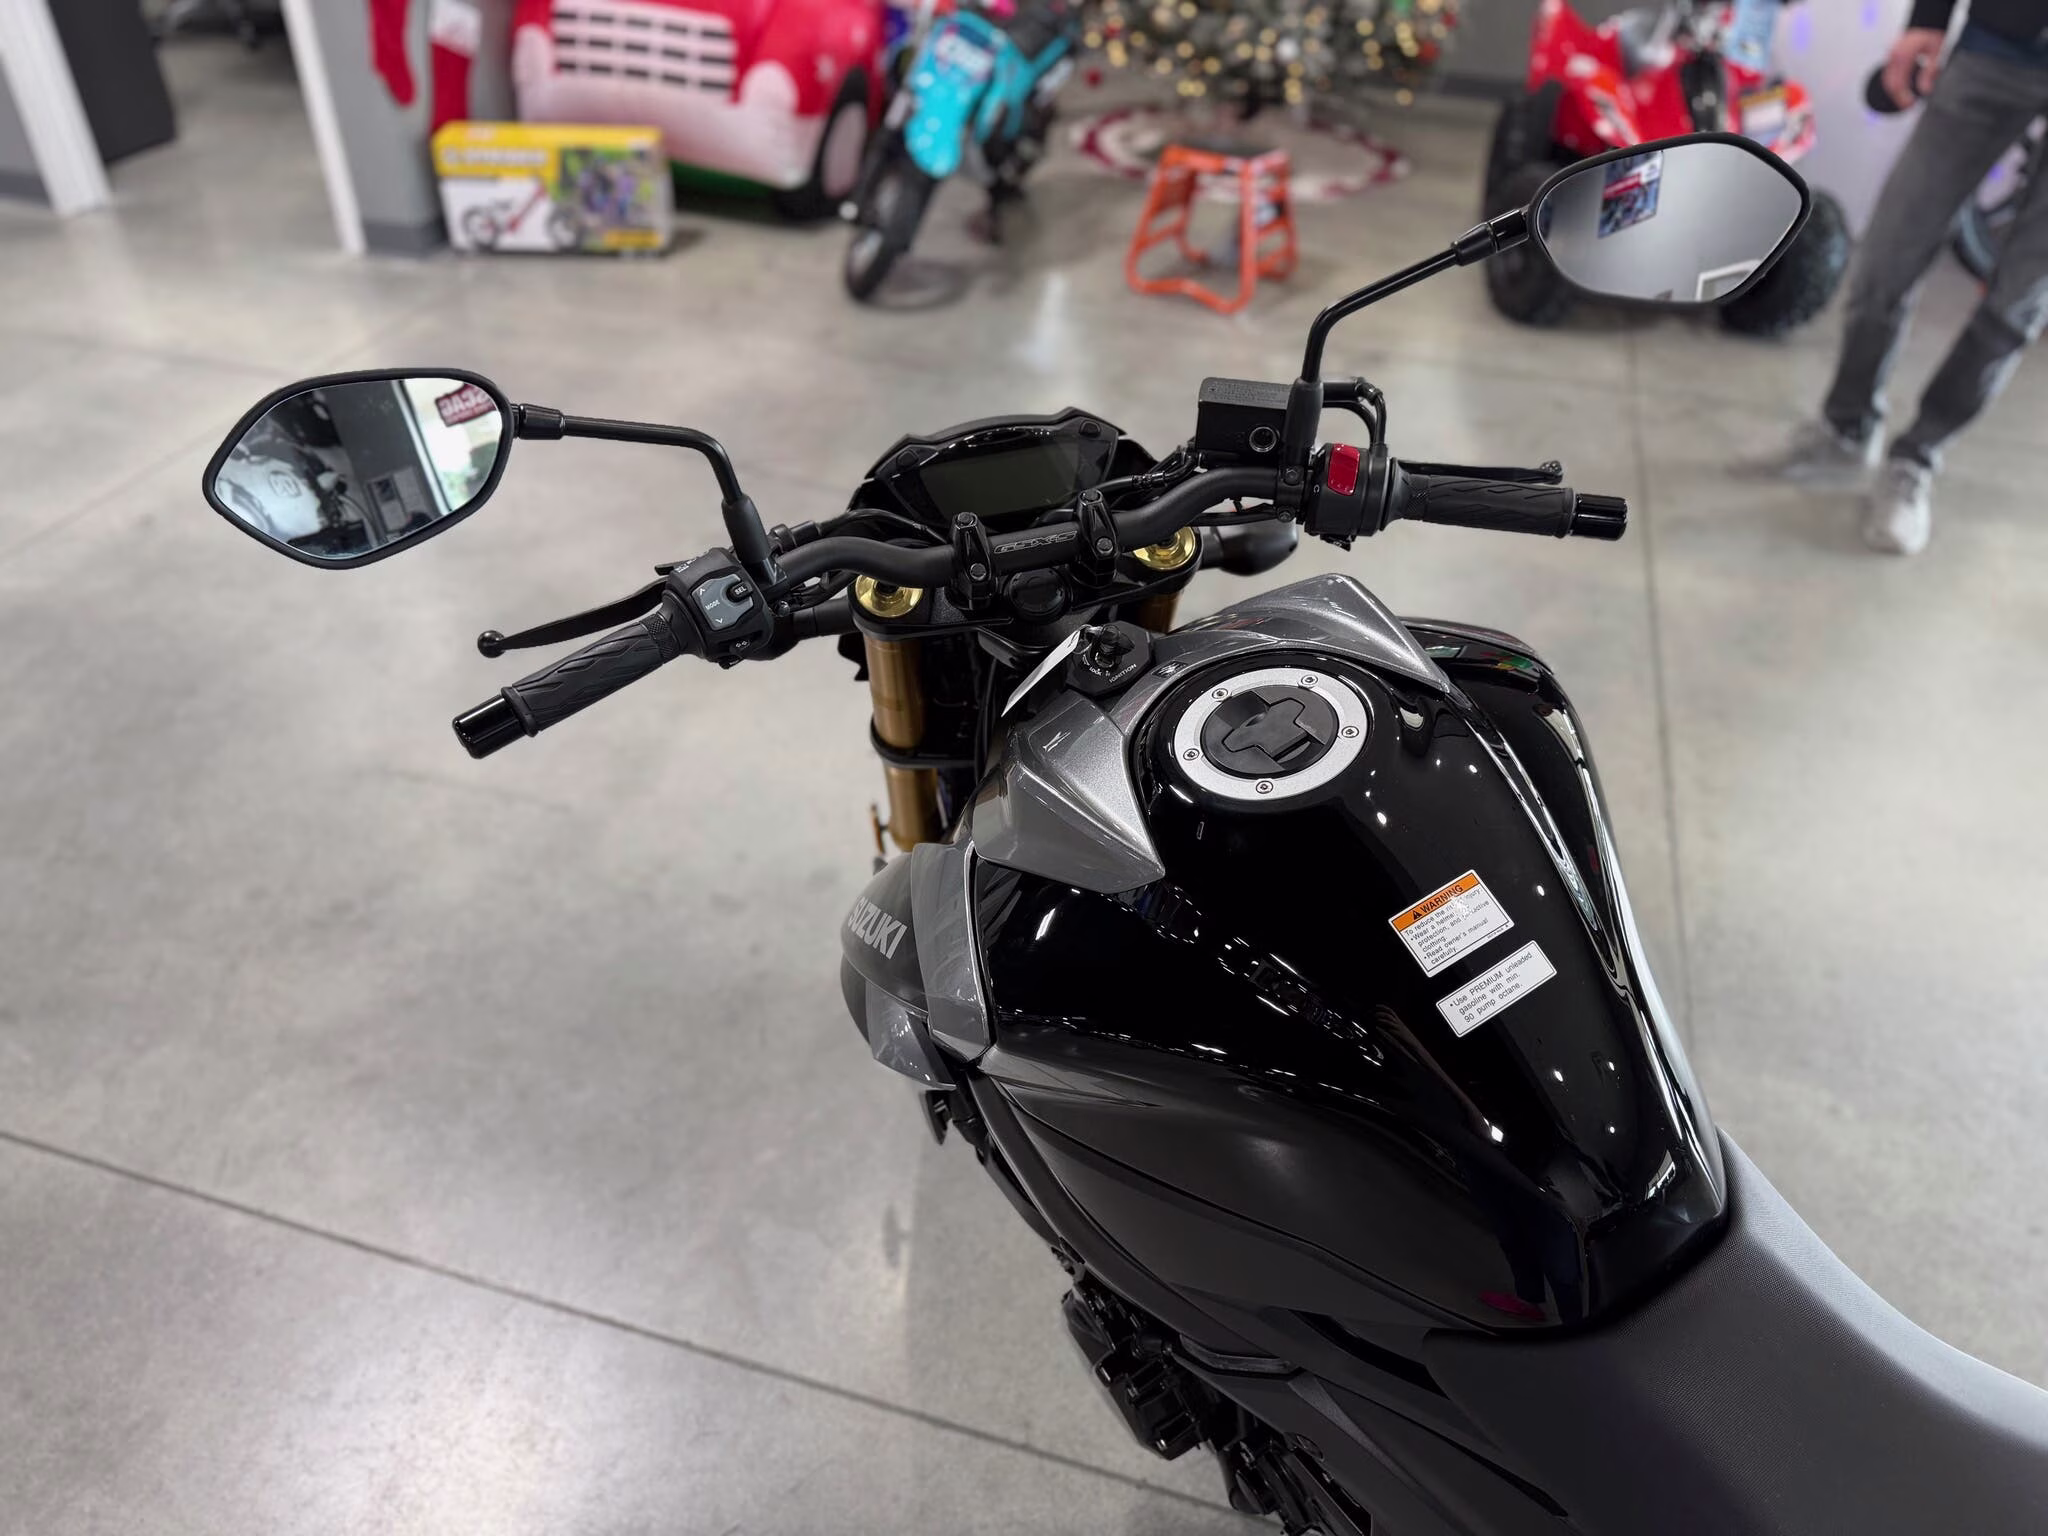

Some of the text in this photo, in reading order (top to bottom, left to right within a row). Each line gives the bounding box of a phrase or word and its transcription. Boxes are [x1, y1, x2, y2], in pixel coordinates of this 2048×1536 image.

[705, 599, 721, 610] MODE
[734, 585, 747, 595] SEL
[1089, 666, 1103, 677] LOCK
[1109, 663, 1137, 683] IGNITION
[1420, 884, 1464, 913] WARNING
[847, 896, 908, 961] SUZUKI
[1405, 928, 1414, 936] To
[1414, 916, 1435, 931] reduce
[1435, 909, 1445, 919] the
[1418, 924, 1450, 948] protection,
[1450, 916, 1461, 927] and
[1422, 935, 1448, 953] clothing.
[1426, 946, 1443, 959] Read
[1444, 931, 1467, 948] owner's
[1467, 917, 1489, 934] manual
[1453, 952, 1533, 1007] Use PREMIUM unleaded
[1459, 972, 1521, 1016] gasoline with min.
[1464, 982, 1523, 1023] 90 pump octane.
